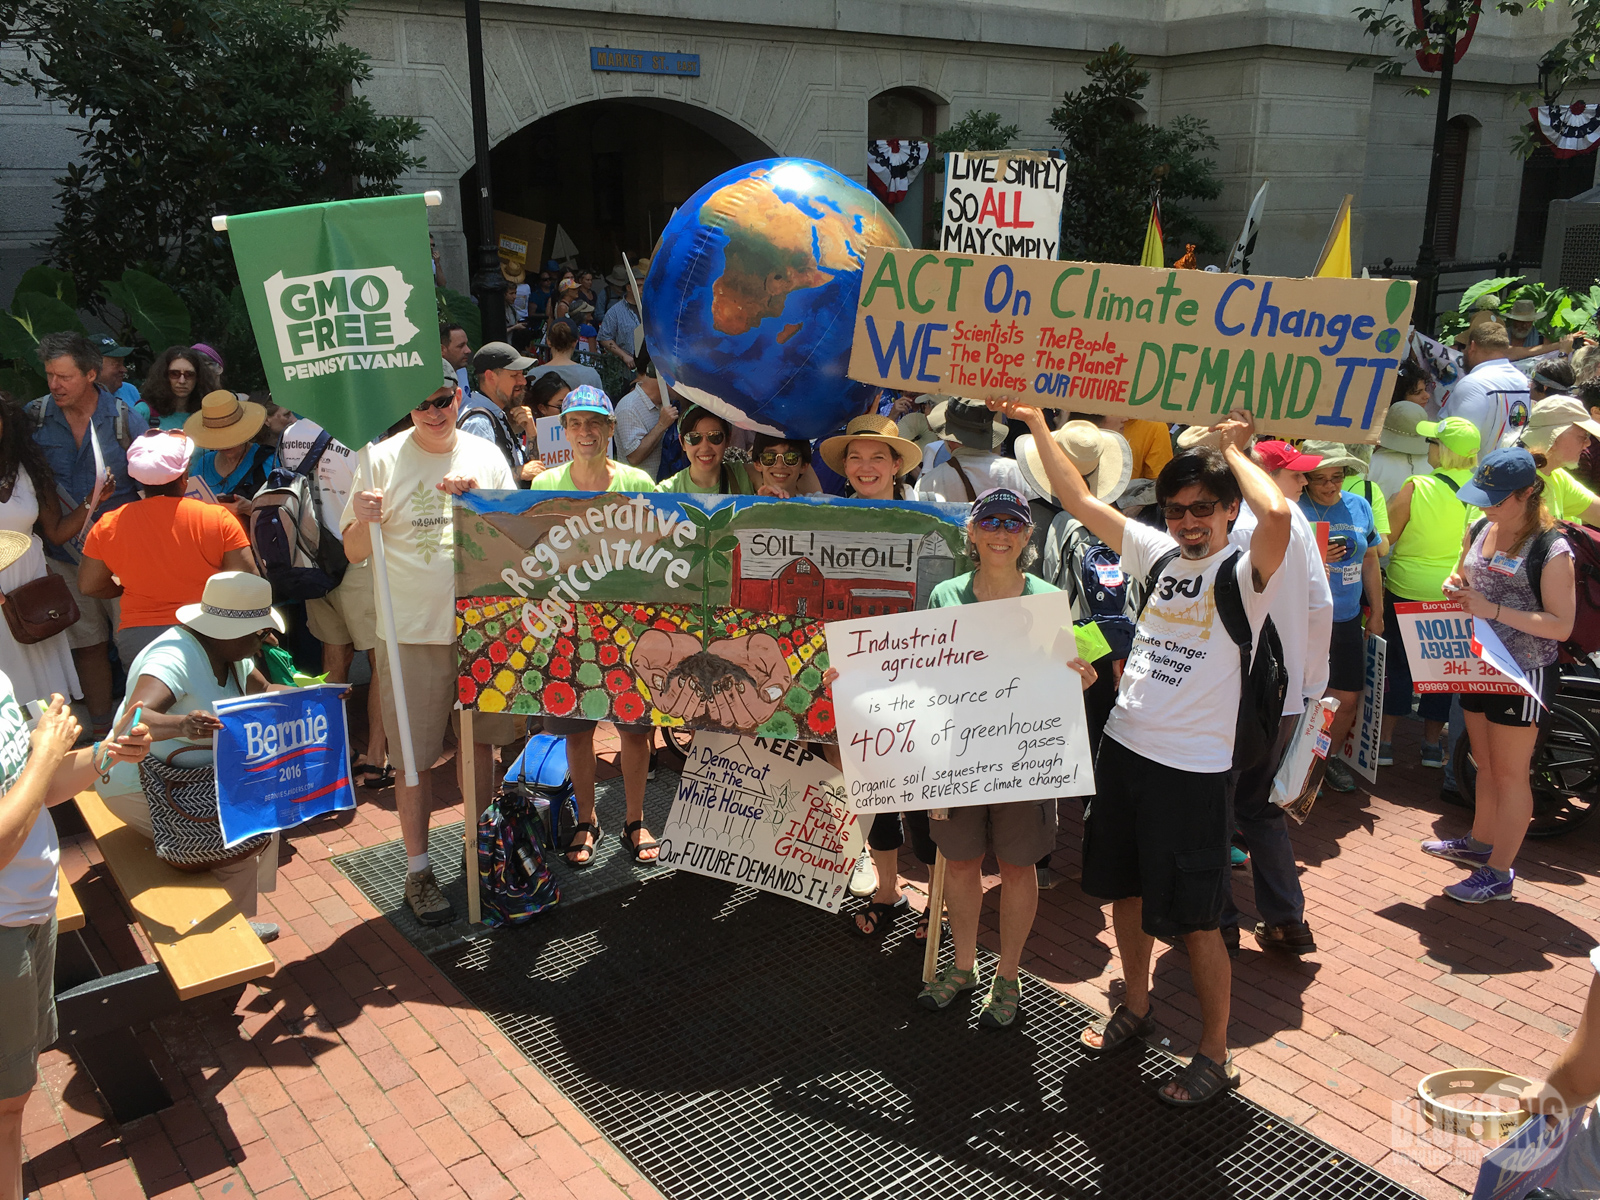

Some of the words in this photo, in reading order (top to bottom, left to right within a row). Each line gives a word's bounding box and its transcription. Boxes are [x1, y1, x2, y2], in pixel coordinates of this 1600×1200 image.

[597, 51, 644, 69] MARKET
[652, 55, 669, 70] ST.
[677, 60, 697, 72] EAST
[952, 154, 998, 183] LIVE
[1003, 157, 1067, 193] SIMPLY
[947, 187, 979, 223] SO
[978, 186, 1035, 229] ALL
[943, 223, 993, 255] MAY
[279, 274, 389, 321] GMO
[860, 251, 975, 314] ACT
[984, 263, 1032, 316] On
[1049, 267, 1199, 326] Climate
[286, 312, 395, 356] FREE
[953, 319, 1024, 344] Scientists
[1039, 327, 1067, 349] The
[1066, 327, 1117, 357] People
[864, 315, 949, 383] WE
[950, 343, 981, 363] The
[986, 343, 1025, 372] Pope
[1035, 350, 1066, 371] The
[1067, 351, 1129, 375] Planet
[283, 351, 424, 381] PENNSYLVANIA
[949, 364, 977, 386] The
[980, 367, 1027, 393] Voters
[1034, 372, 1070, 398] OUR
[1069, 376, 1130, 403] FUTURE
[1128, 342, 1322, 420] DEMAND
[1314, 357, 1399, 430] IT
[550, 426, 564, 442] IT'
[540, 448, 575, 466] EMER
[501, 493, 697, 598] Regenerative
[750, 532, 815, 556] SOIL!
[847, 619, 958, 657] Industrial
[1415, 618, 1473, 641] UTION
[881, 647, 989, 682] agriculture
[1420, 641, 1478, 659] NERGY
[1151, 668, 1183, 687] time!
[1417, 683, 1449, 691] 69866
[1451, 683, 1466, 691] TO
[1468, 683, 1531, 694] VOLUTION
[868, 698, 881, 714] is
[888, 694, 915, 711] the
[928, 688, 988, 708] source
[995, 677, 1021, 699] of
[1358, 635, 1378, 769] PIPELINE
[244, 707, 328, 760] Bernie
[850, 719, 916, 762] 40%
[930, 719, 955, 746] of
[956, 712, 1063, 757] greenhouse
[1012, 735, 1070, 764] gases.
[279, 764, 302, 783] 2016
[688, 746, 698, 761] A
[700, 747, 771, 781] Democrat
[705, 767, 717, 781] in
[721, 771, 743, 788] the
[851, 778, 897, 798] Organic
[902, 766, 926, 786] soil
[935, 760, 1003, 784] sequesters
[1011, 752, 1063, 776] enough
[678, 779, 717, 809] White
[718, 787, 764, 820] House
[855, 793, 896, 809] carbon
[900, 788, 915, 802] to
[921, 779, 980, 800] REVERSE
[984, 774, 1022, 793] climate
[1028, 763, 1079, 789] change!
[801, 784, 858, 826] Fossil
[804, 808, 850, 842] Fuels
[774, 836, 856, 876] Ground!
[821, 833, 844, 854] the
[657, 839, 681, 863] Our
[680, 841, 740, 876] FUTURE
[736, 856, 806, 895] DEMANDS
